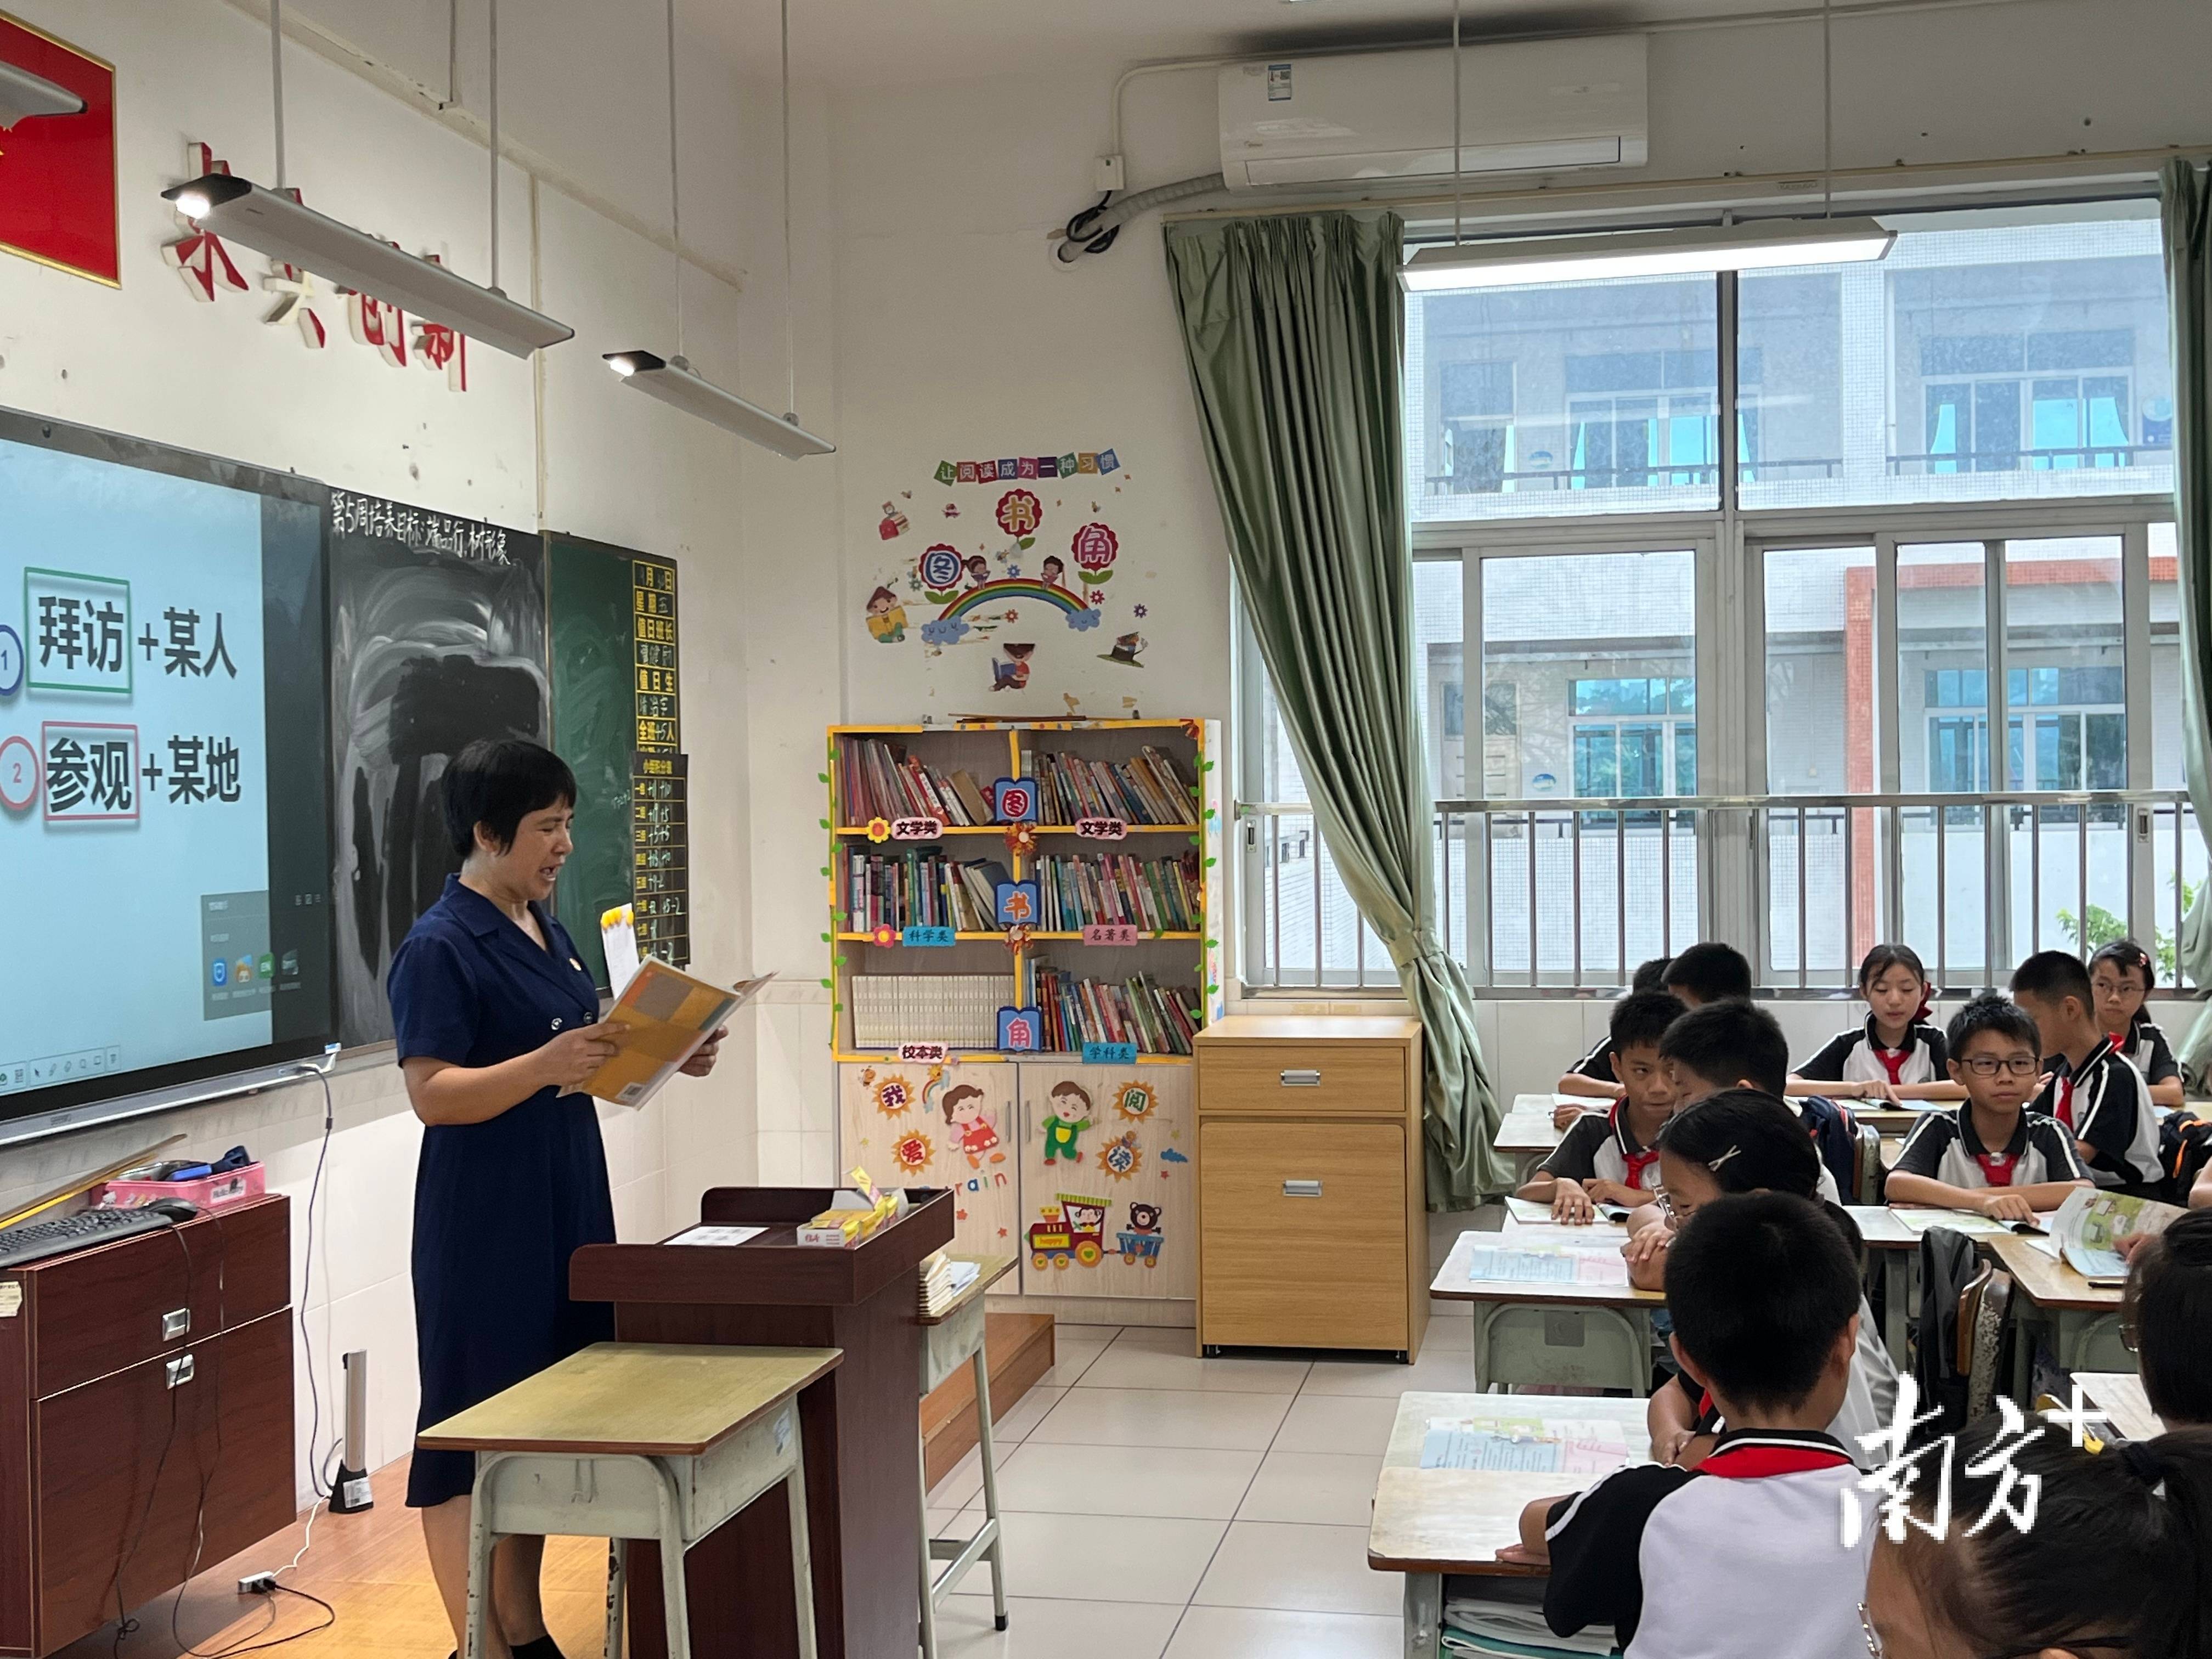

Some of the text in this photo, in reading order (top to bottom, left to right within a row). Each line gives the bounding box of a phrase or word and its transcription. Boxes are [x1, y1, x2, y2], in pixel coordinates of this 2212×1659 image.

[940, 452, 1115, 481] 让阅读成为一种习惯
[1001, 495, 1036, 532] 书
[1076, 527, 1113, 565] 角
[14, 763, 21, 783] 2
[897, 820, 938, 834] 文学类
[1080, 820, 1122, 834] 文学类
[1005, 892, 1030, 920] 书
[909, 930, 949, 943] 科学类
[1091, 928, 1131, 941] 名著类
[1006, 1018, 1031, 1048] 角
[901, 1045, 943, 1059] 校本类
[1090, 1047, 1130, 1060] 学科类
[882, 1085, 925, 1163] 我 爱
[1108, 1088, 1147, 1170] 阅 读
